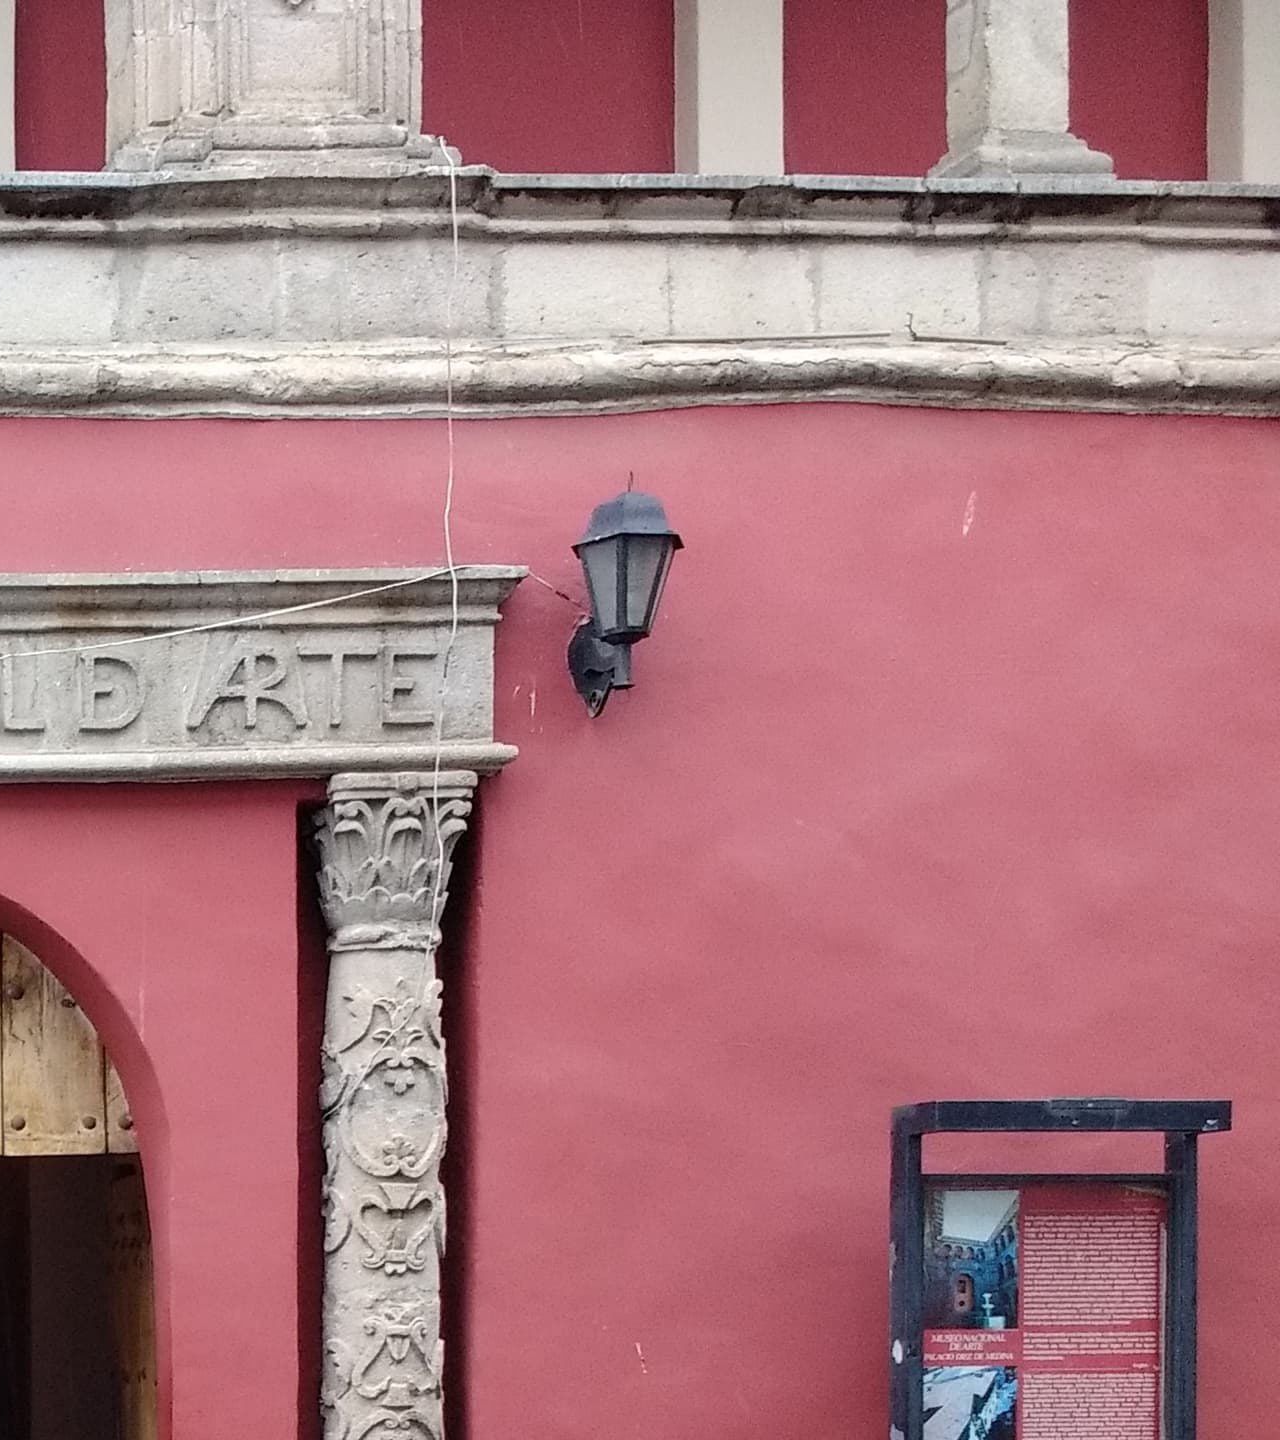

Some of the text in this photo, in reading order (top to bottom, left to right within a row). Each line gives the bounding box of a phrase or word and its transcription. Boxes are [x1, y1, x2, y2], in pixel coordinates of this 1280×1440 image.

[185, 648, 439, 731] ARTE
[931, 1334, 1007, 1343] MUSEO NACIONAL
[949, 1343, 985, 1351] DE ARTE
